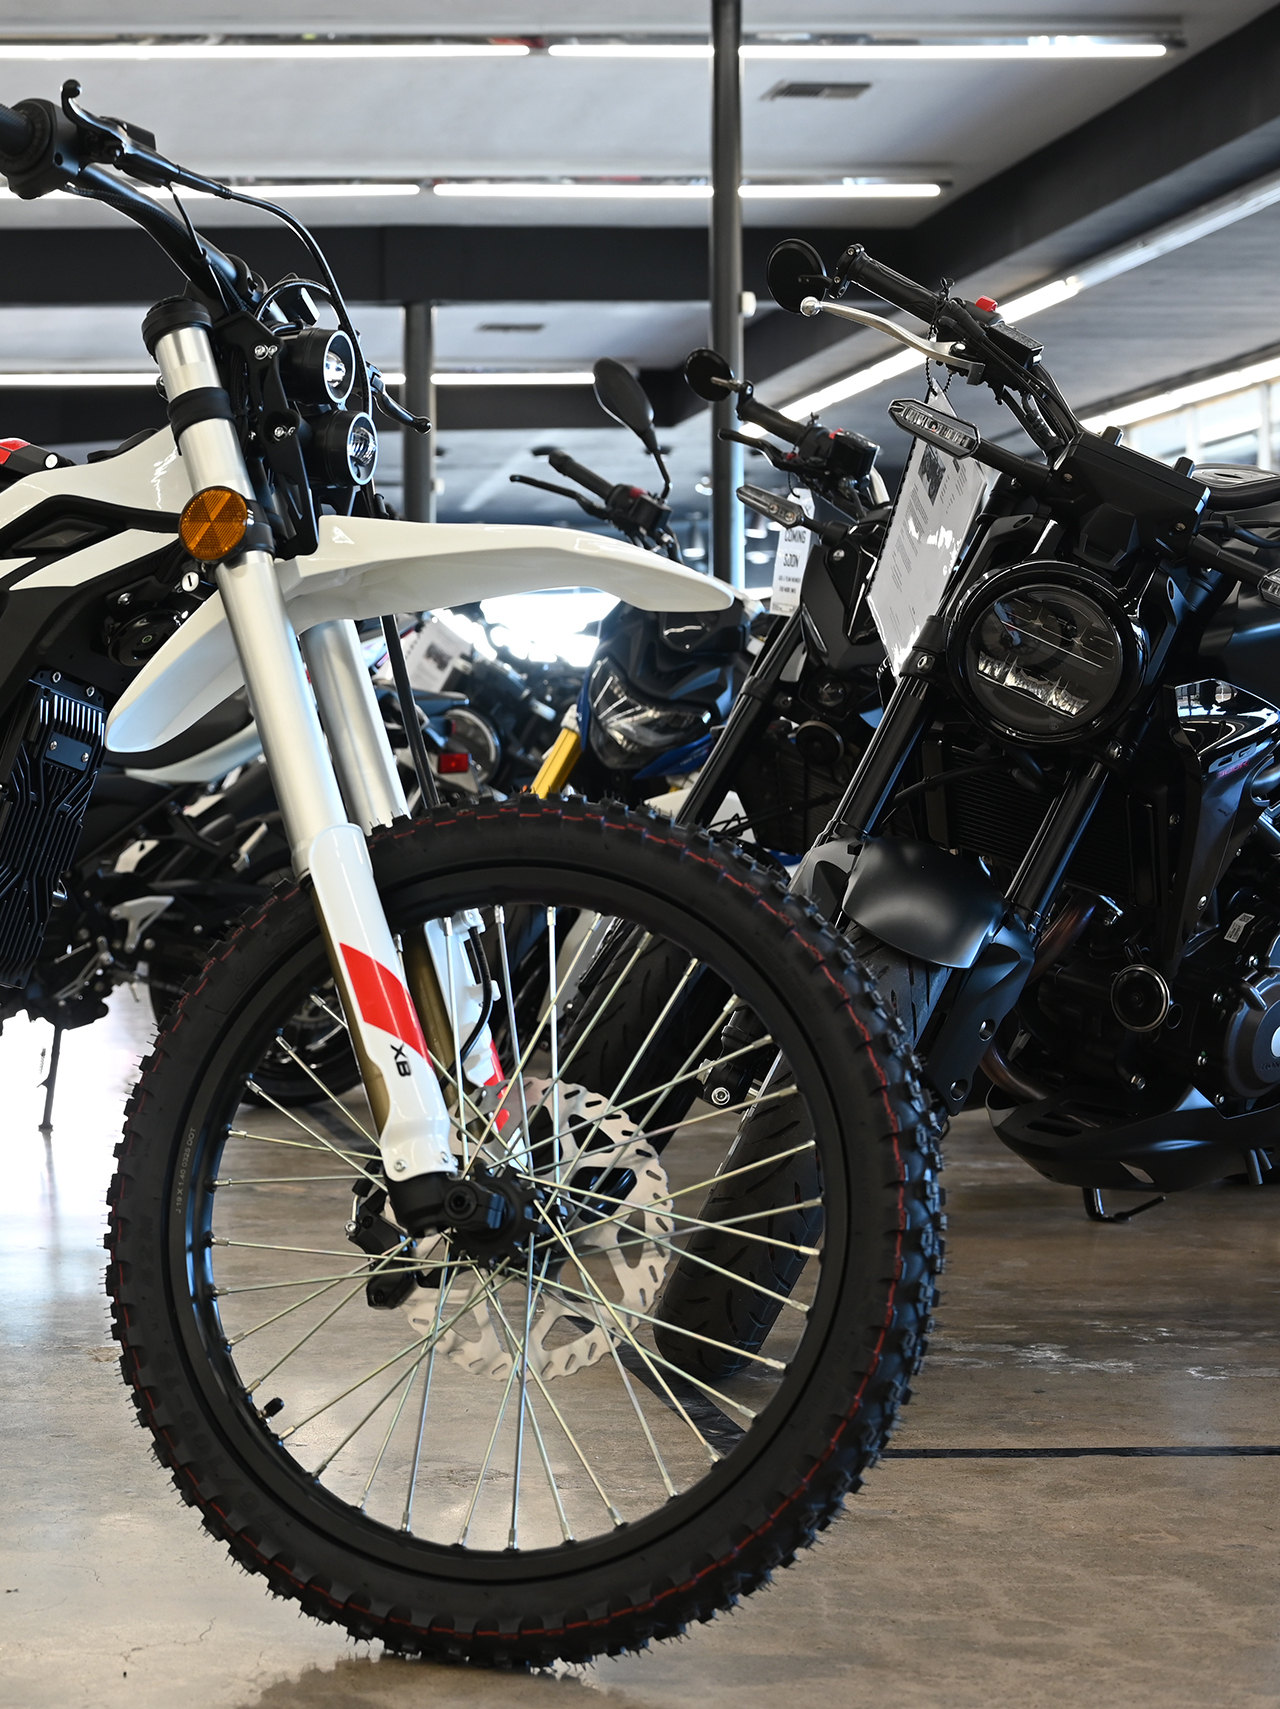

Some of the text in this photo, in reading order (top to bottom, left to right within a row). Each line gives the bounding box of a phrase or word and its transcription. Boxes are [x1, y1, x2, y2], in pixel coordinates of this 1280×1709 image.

[783, 553, 799, 567] SOON
[389, 1043, 411, 1077] XB
[176, 1196, 183, 1206] 19
[186, 1127, 196, 1146] DOT
